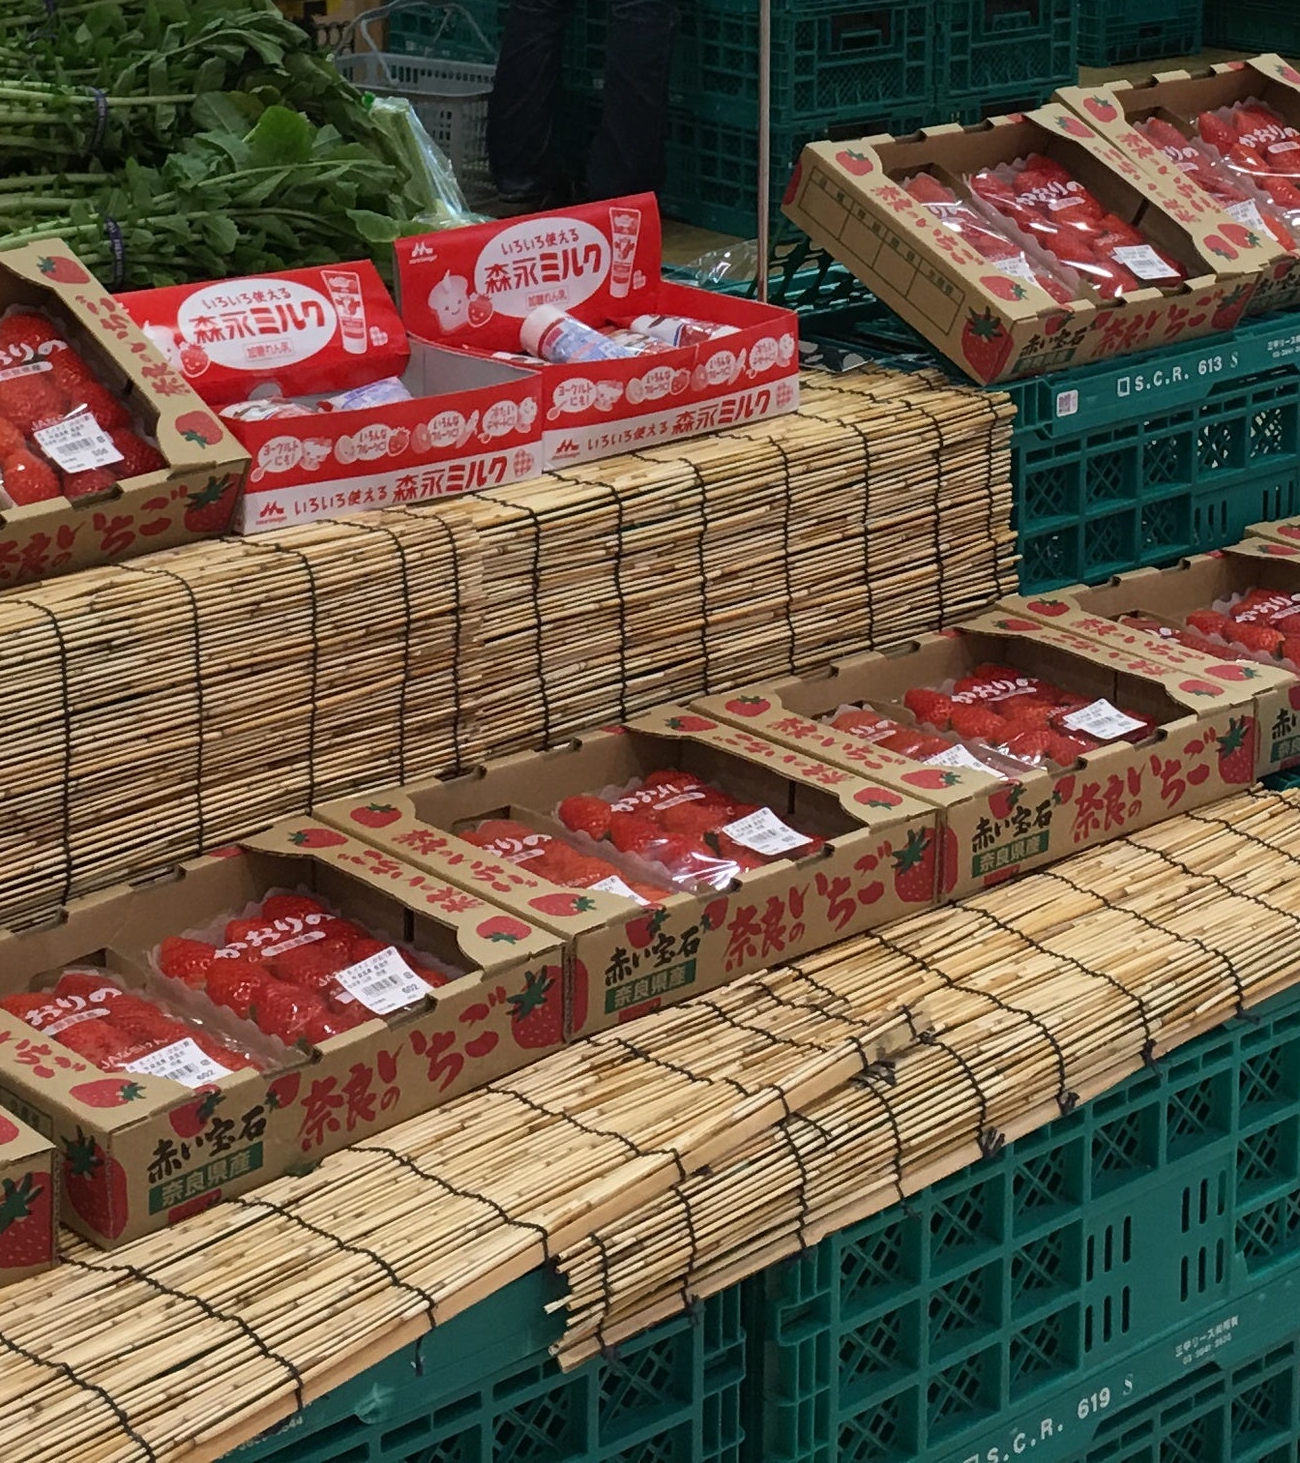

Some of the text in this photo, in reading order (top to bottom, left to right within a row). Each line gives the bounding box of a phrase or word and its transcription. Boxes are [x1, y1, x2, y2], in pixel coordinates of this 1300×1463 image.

[483, 242, 602, 295] 森永ミルク
[501, 228, 580, 256] いろいろ使える
[188, 299, 326, 345] 森永ミルク
[202, 287, 293, 310] いろいろ使える
[1133, 366, 1190, 394] S.C.R.
[1197, 355, 1224, 376] 613
[587, 389, 771, 452] いろいろ使える 森永ミルク
[293, 455, 509, 516] いろいろ使える 森永ミルク
[970, 726, 1217, 853] 赤い宝石 奈良のいちご
[214, 912, 337, 960] かおりの
[604, 839, 893, 985] 赤い宝石 奈良のいちご
[145, 984, 509, 1181] 赤い宝石 奈良のいちご
[158, 1148, 258, 1210] 奈良県産
[985, 1413, 1066, 1463] S.C.R.
[1075, 1387, 1113, 1423] 619
